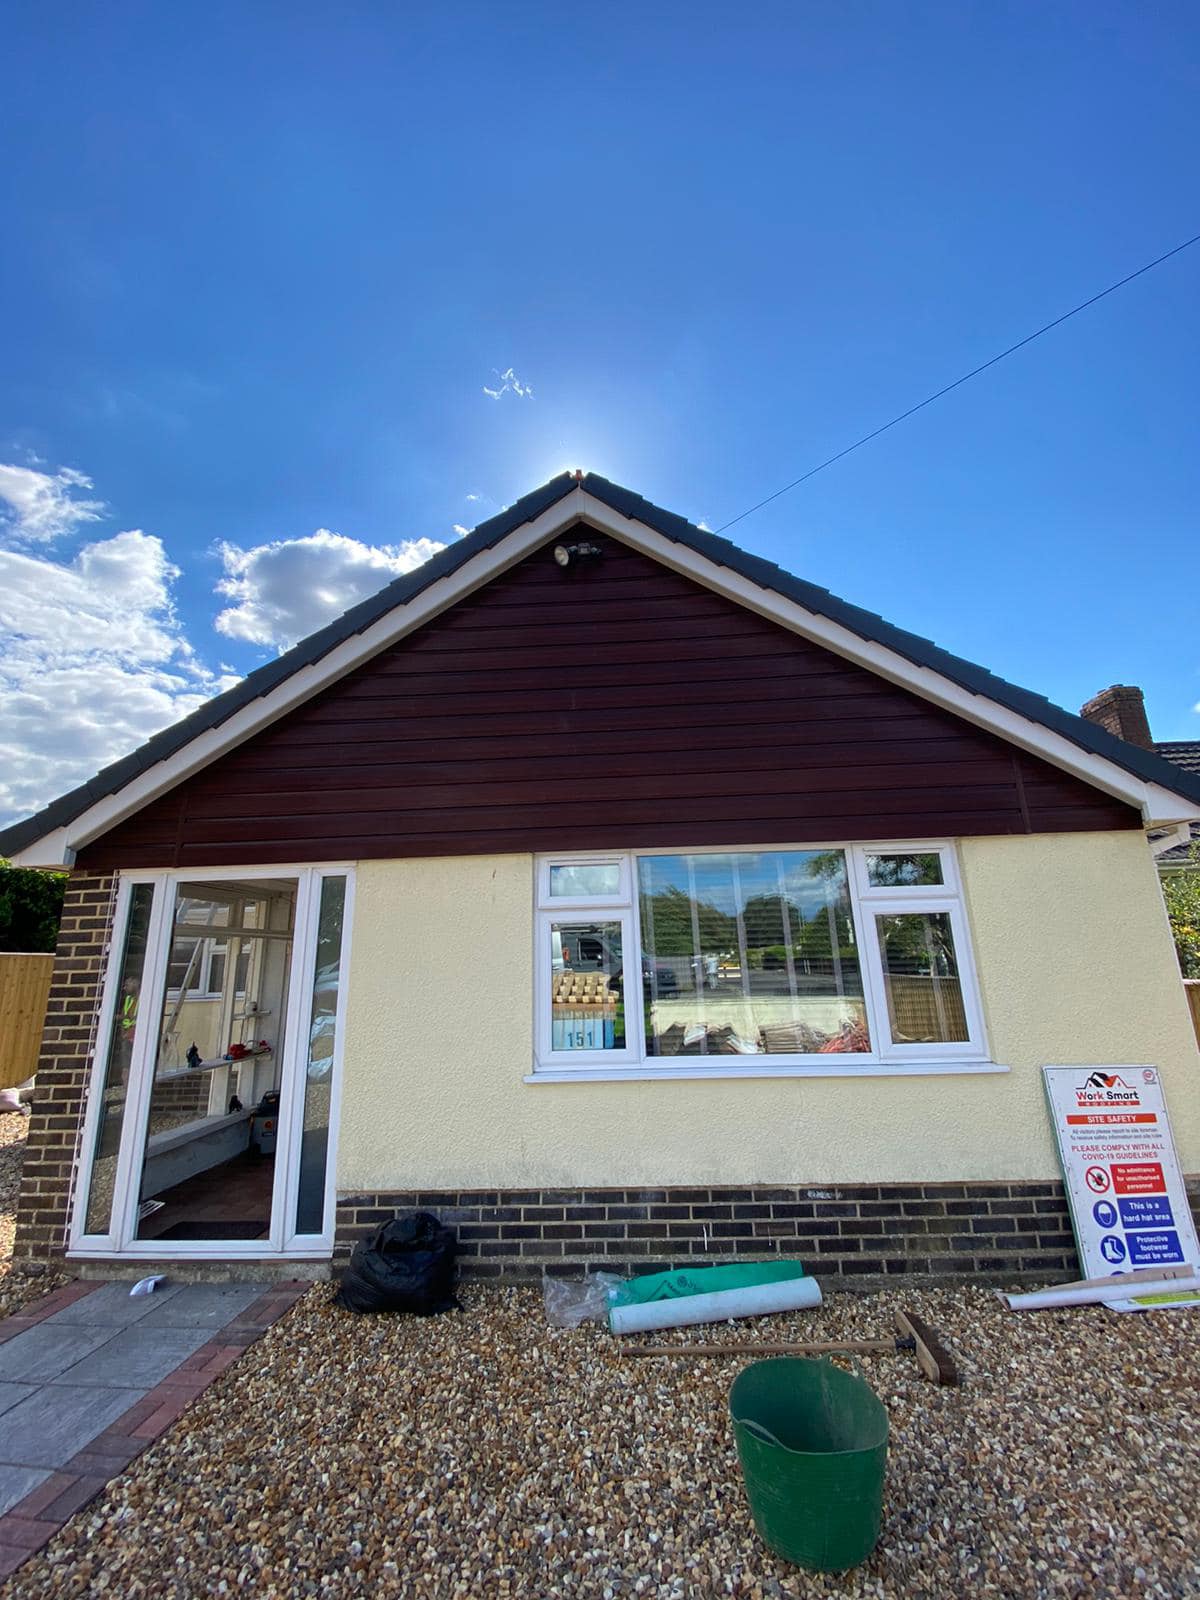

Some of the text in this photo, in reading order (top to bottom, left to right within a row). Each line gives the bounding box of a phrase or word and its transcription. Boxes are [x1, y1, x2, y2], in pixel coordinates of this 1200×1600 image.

[567, 1031, 593, 1048] 151
[1076, 1091, 1139, 1100] Work Smart
[1087, 1115, 1137, 1123] SITE SAFETY
[1146, 1201, 1153, 1209] is
